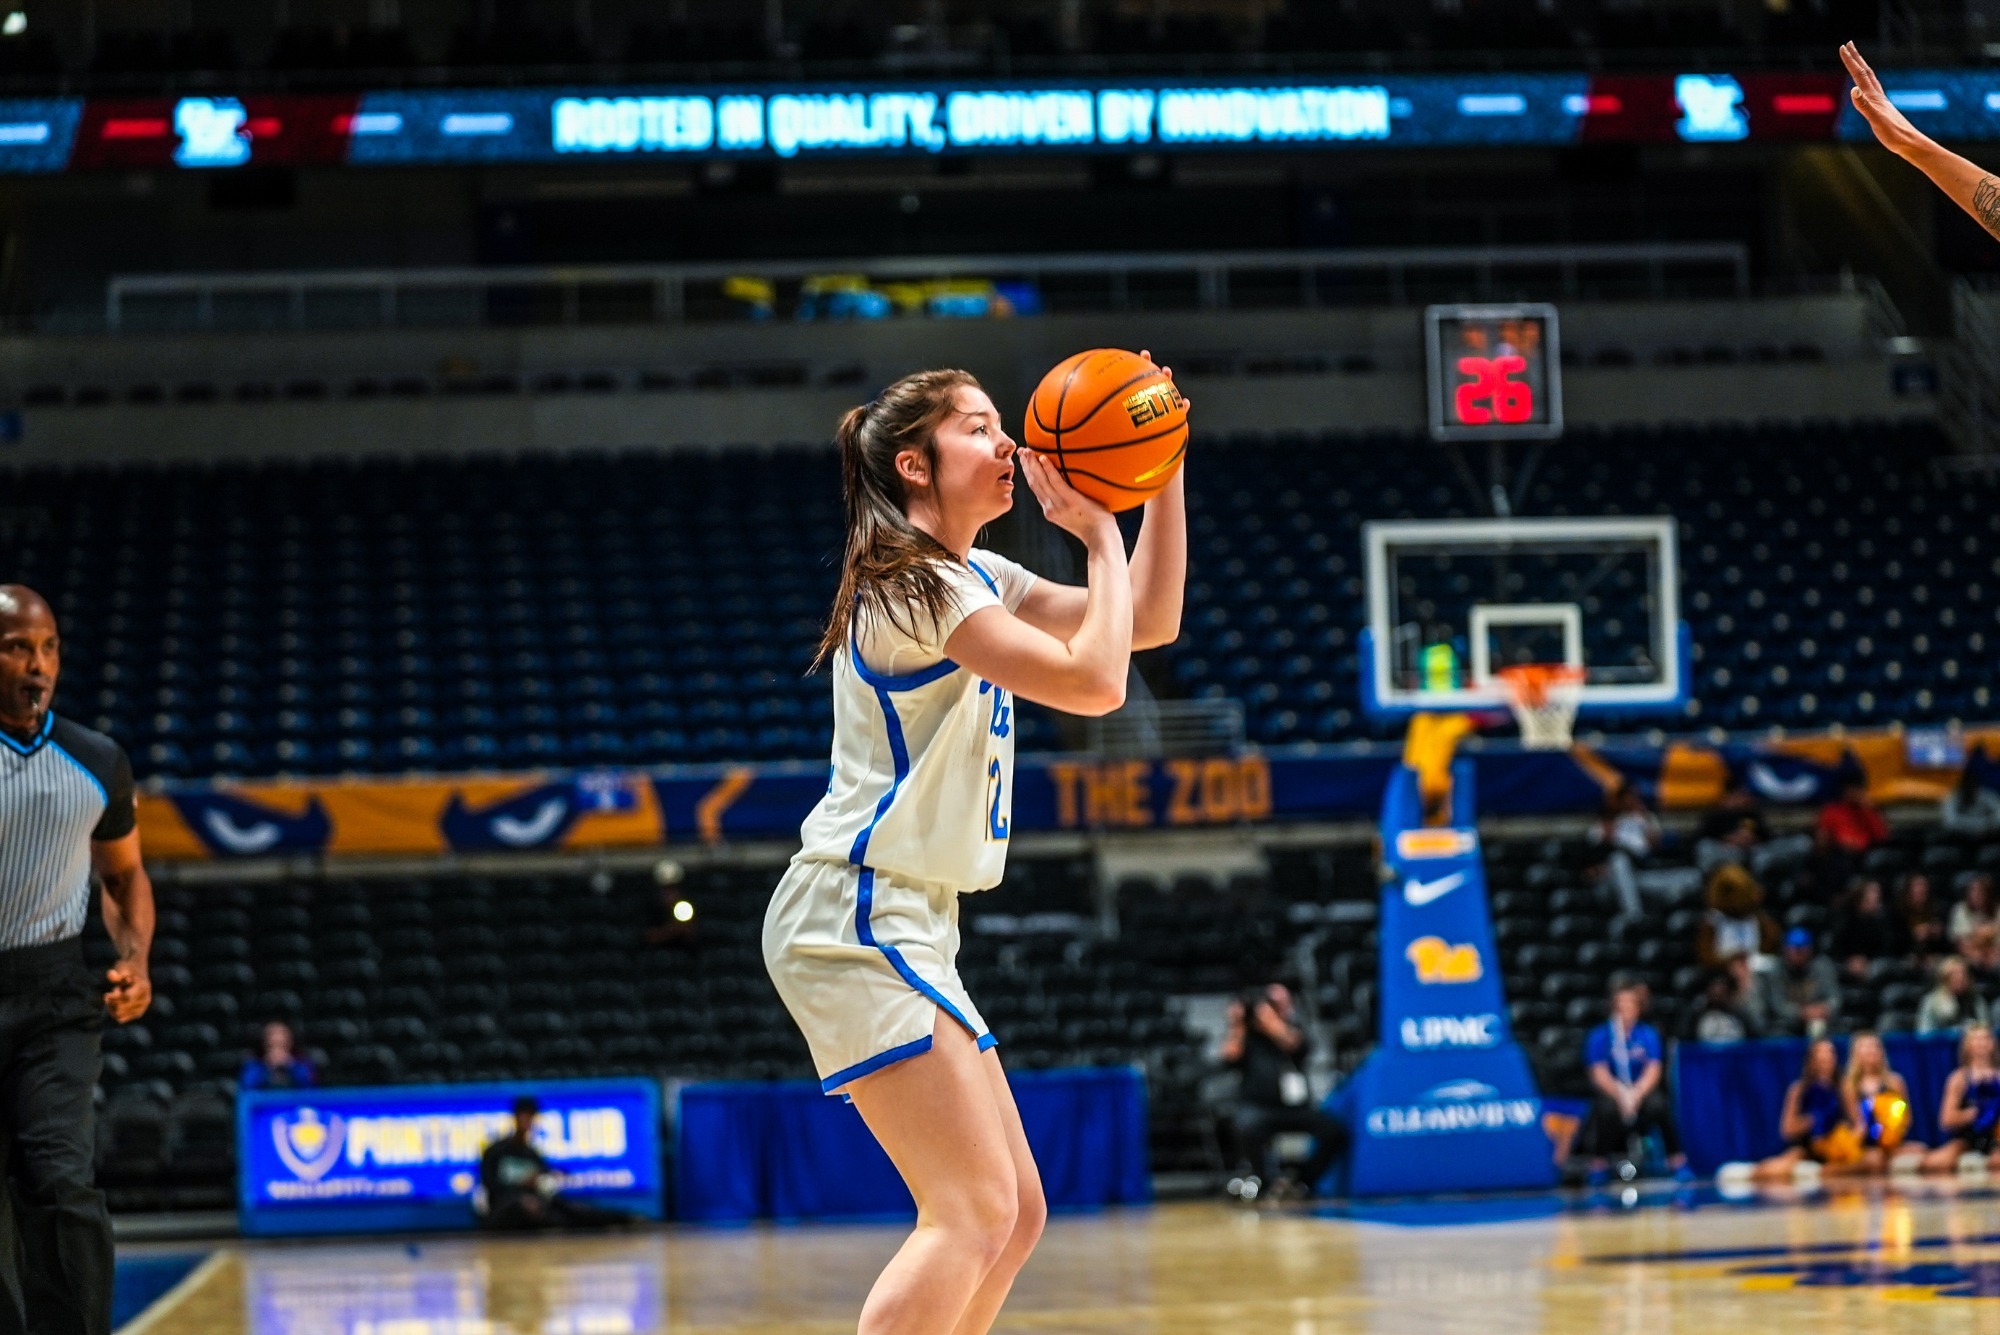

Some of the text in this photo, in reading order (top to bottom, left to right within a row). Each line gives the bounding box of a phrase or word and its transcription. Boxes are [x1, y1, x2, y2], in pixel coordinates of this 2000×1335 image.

[553, 97, 715, 152] ROOTED
[716, 95, 765, 149] IN
[947, 90, 1097, 146] DRIVEN
[1098, 89, 1155, 143] BY
[1157, 86, 1391, 140] INNOVATION
[1455, 355, 1533, 424] 26
[1050, 756, 1272, 826] THE ZOO
